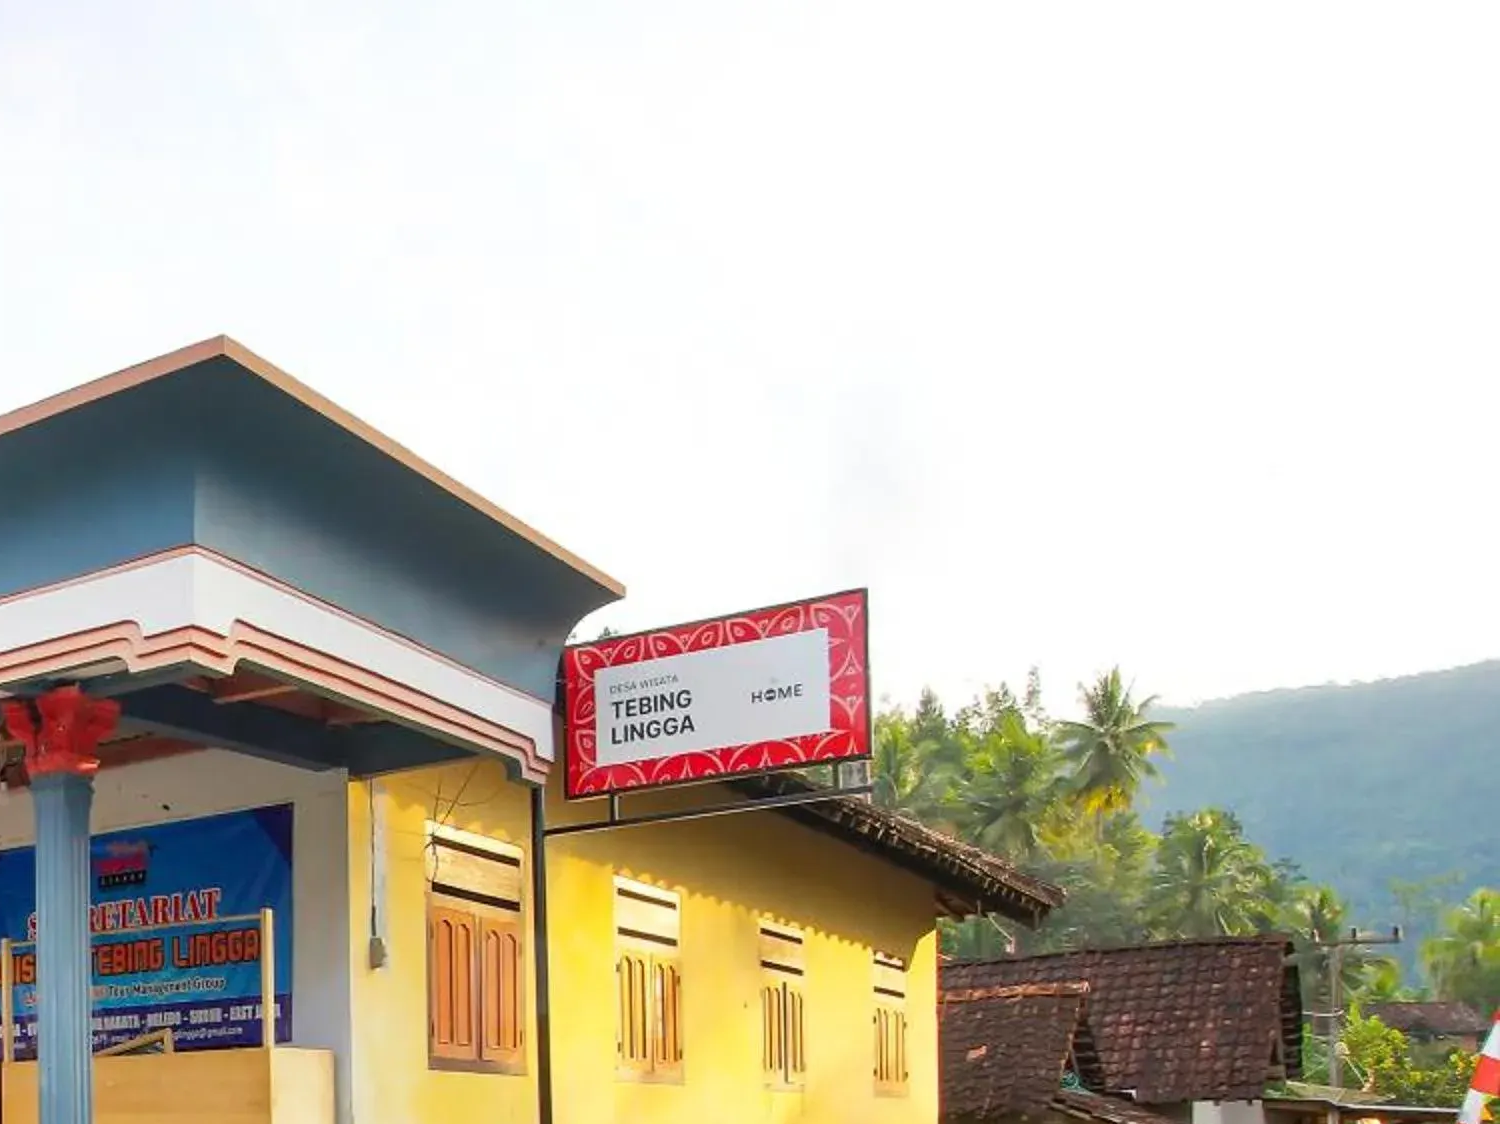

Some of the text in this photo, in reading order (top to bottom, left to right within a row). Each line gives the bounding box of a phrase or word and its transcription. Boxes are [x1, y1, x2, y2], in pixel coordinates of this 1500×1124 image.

[609, 674, 679, 694] DESA WISATA
[751, 683, 803, 703] HOME
[611, 689, 692, 719] TEBING
[611, 715, 695, 745] LINGGA
[27, 887, 221, 941] SRETARIAT
[173, 929, 261, 969] LINGGA
